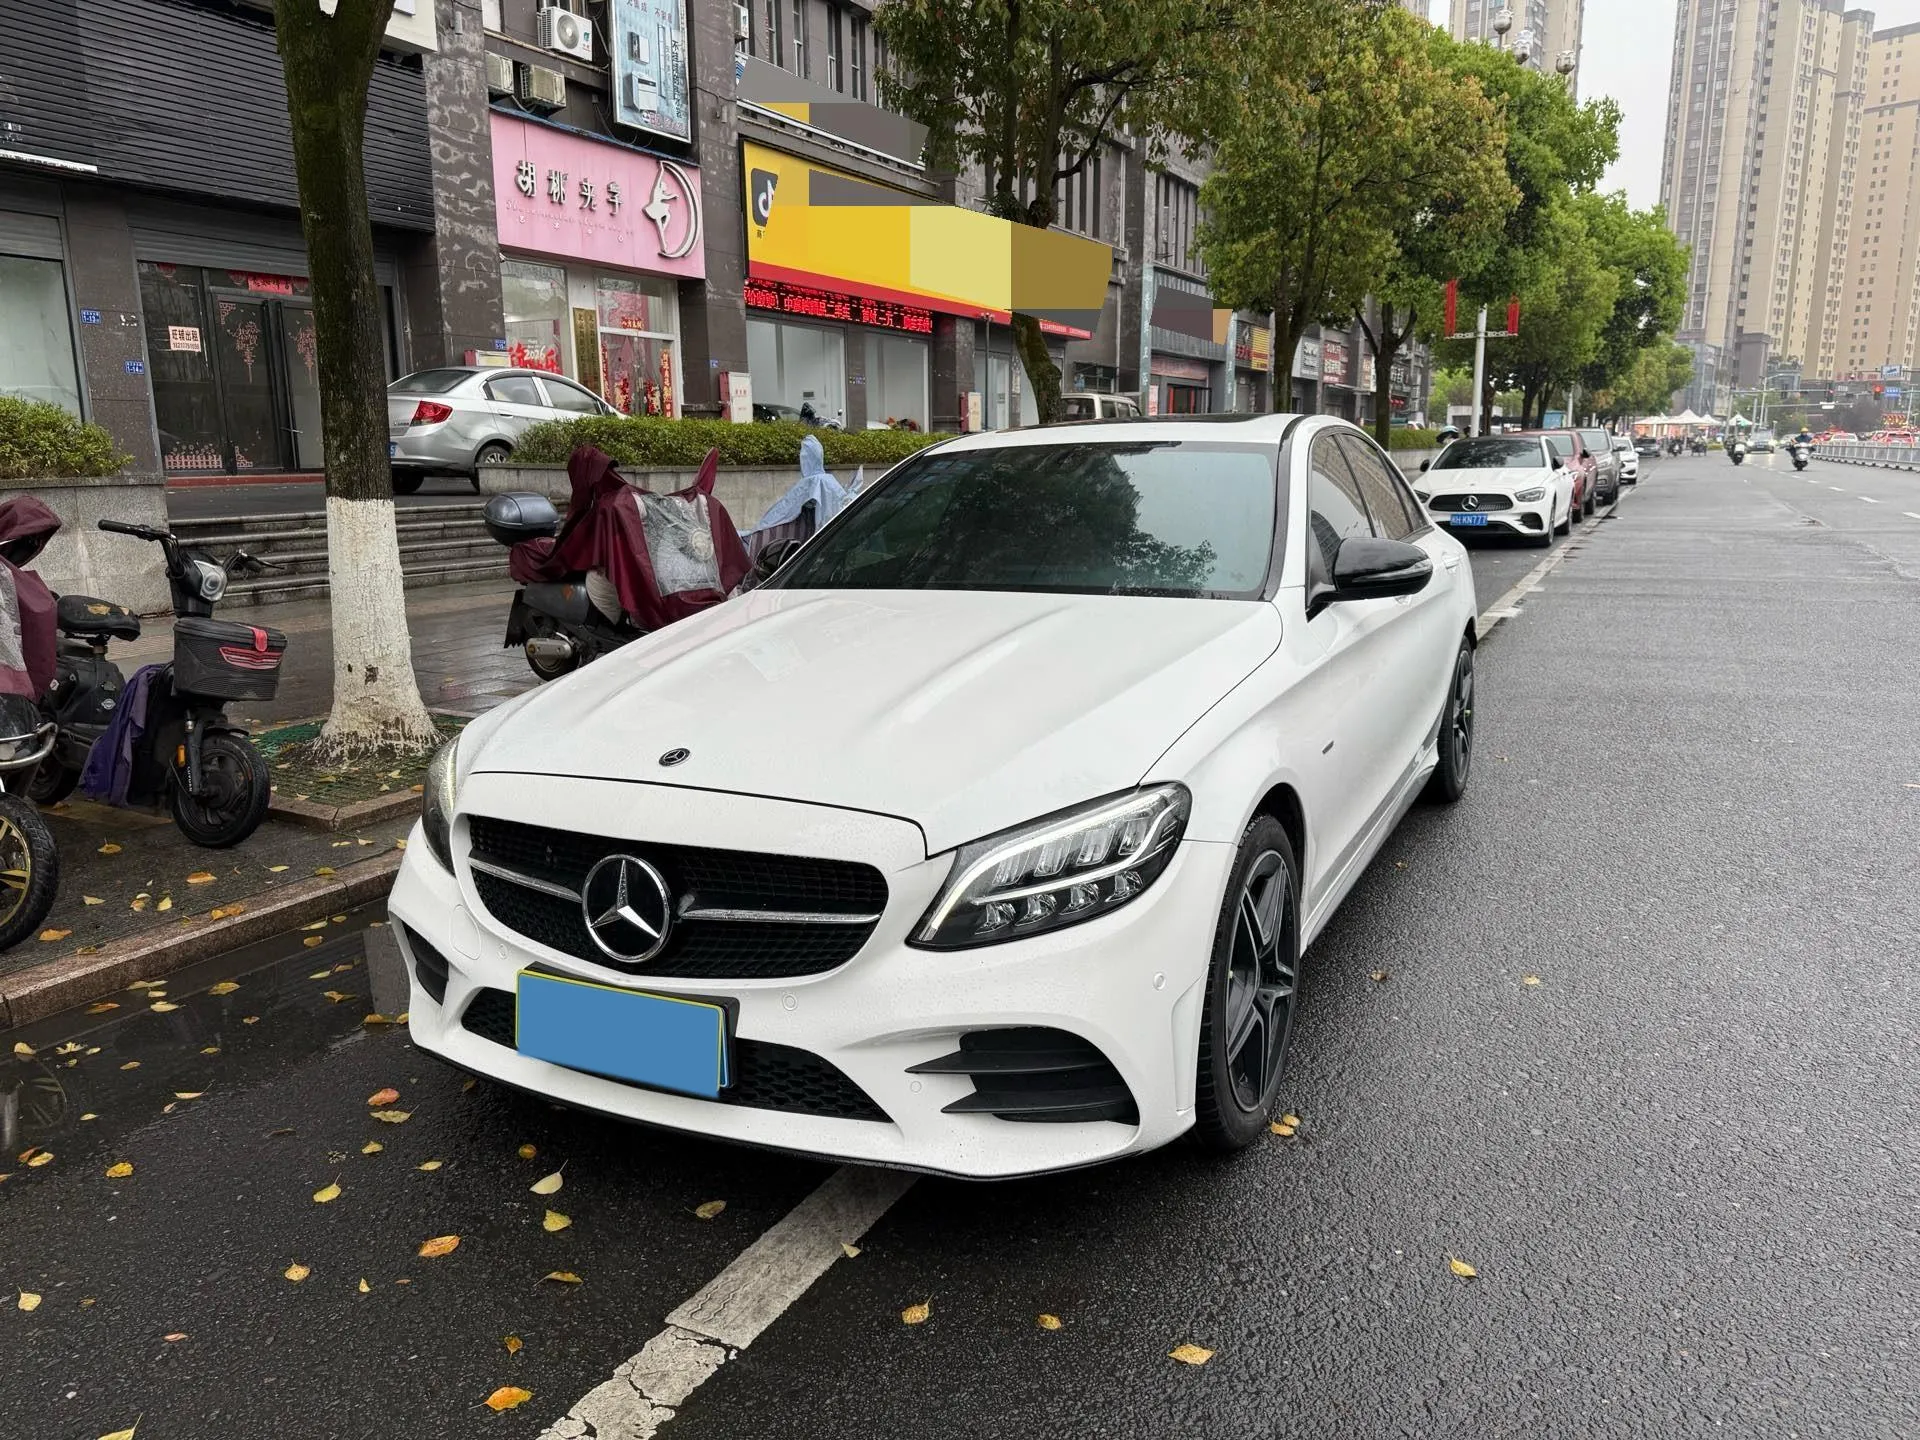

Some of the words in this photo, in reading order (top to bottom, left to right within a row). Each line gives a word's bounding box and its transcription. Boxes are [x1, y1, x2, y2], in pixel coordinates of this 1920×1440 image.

[514, 160, 623, 217] 胡桃夹子
[524, 345, 546, 361] 2026
